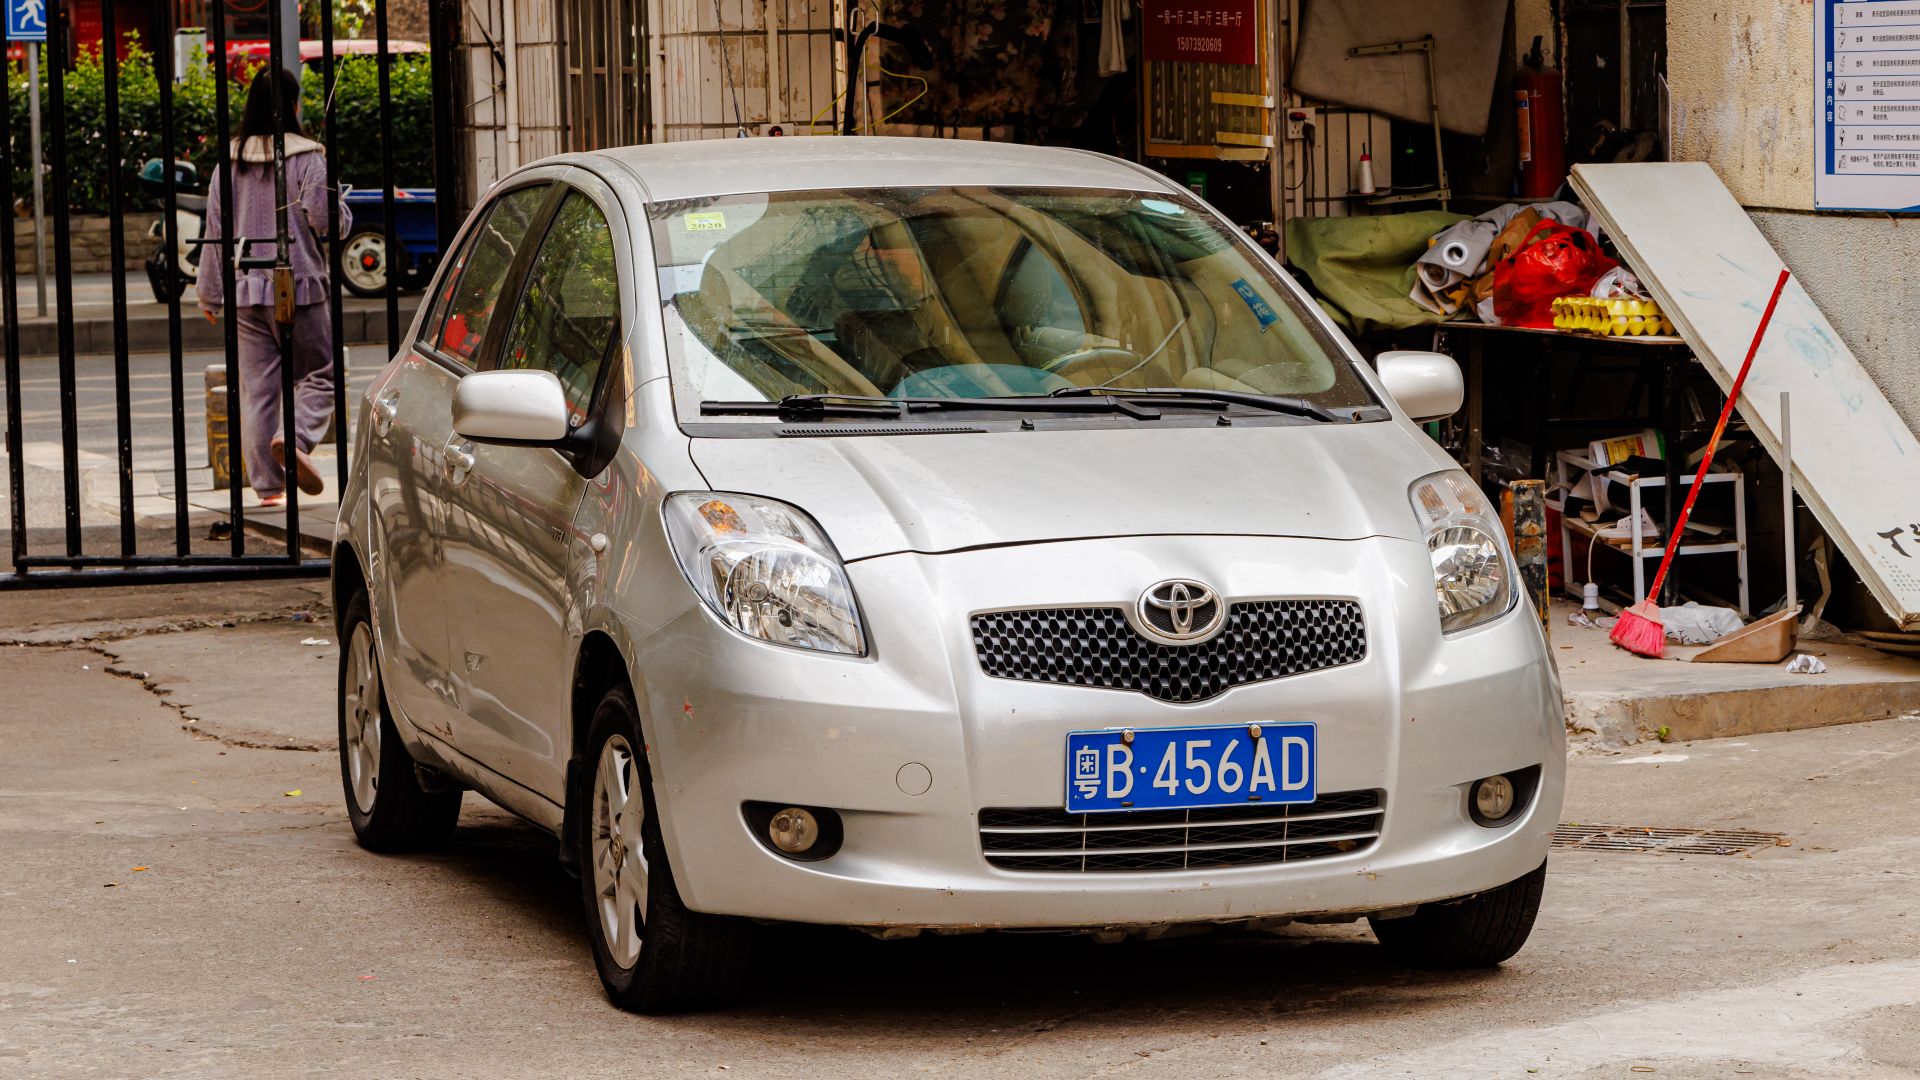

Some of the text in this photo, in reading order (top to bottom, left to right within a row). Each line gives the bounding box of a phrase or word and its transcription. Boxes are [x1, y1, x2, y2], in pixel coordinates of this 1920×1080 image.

[1157, 10, 1242, 27] 一房一厅 二房一厅 三房一厅
[1177, 36, 1222, 53] 15073920609
